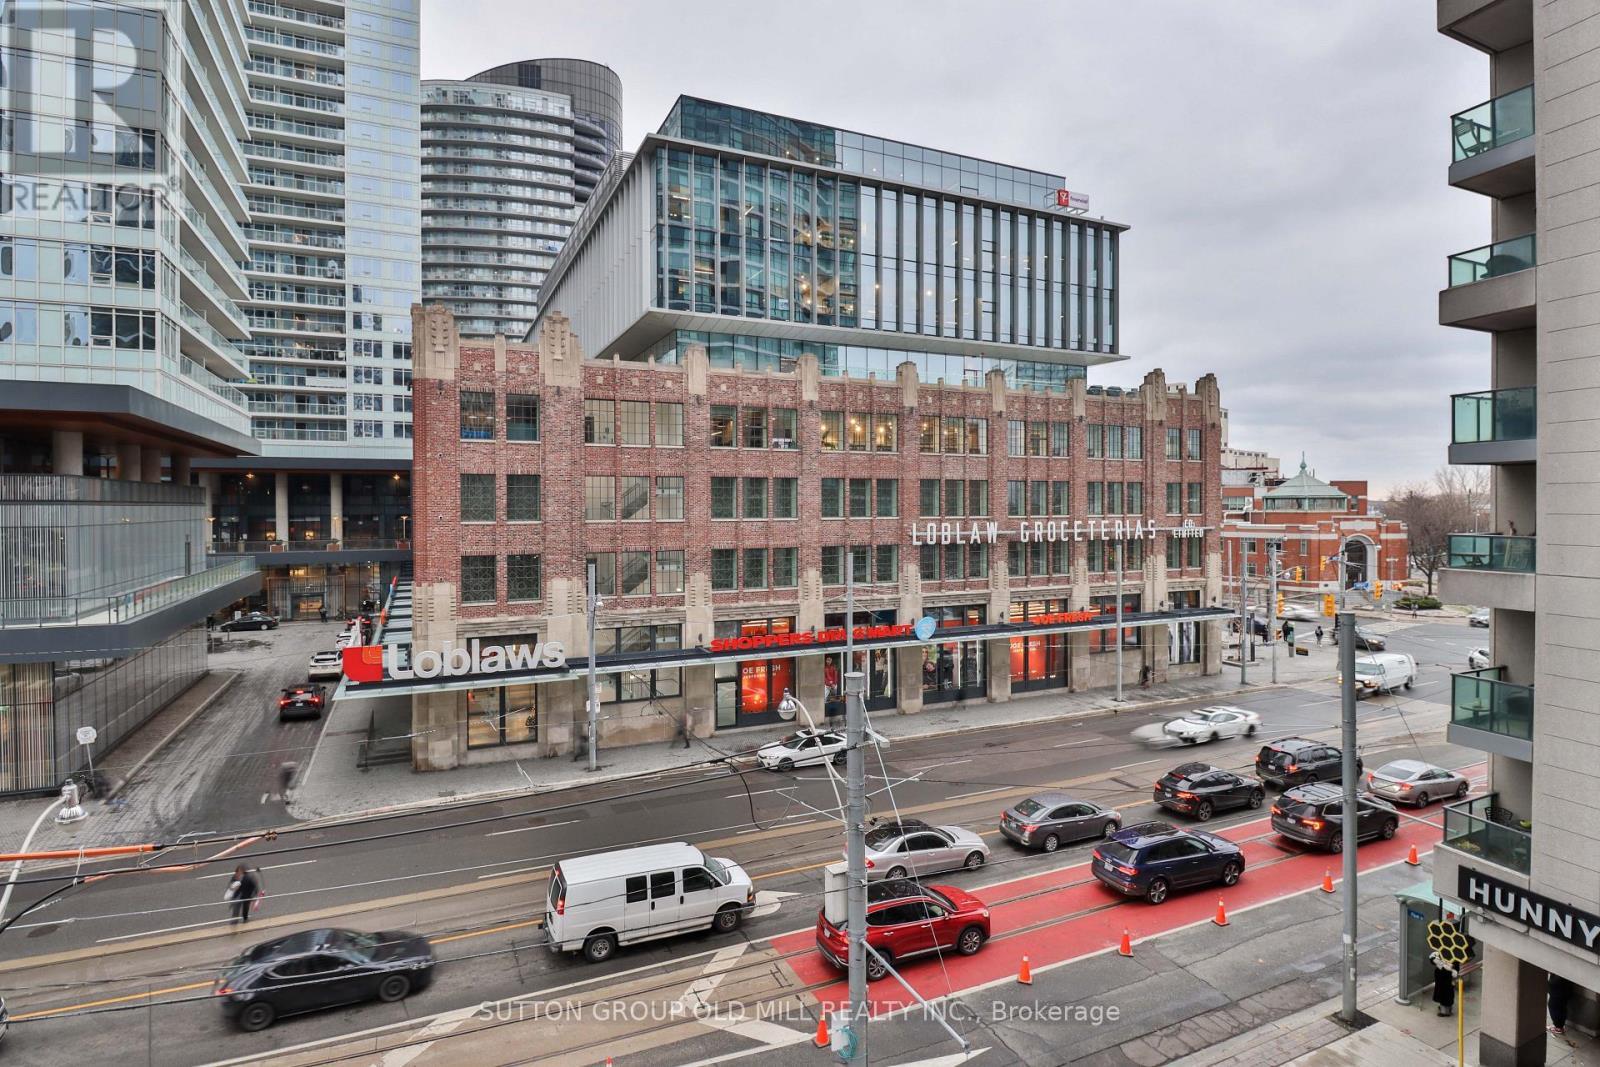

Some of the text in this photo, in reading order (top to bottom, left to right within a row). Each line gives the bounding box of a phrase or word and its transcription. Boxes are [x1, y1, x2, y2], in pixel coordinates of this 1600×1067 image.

[912, 519, 1156, 546] LOBLAW GROCETERIAS
[710, 631, 813, 652] SHOPPERS
[867, 624, 913, 638] MART
[387, 638, 566, 680] Loblaws
[756, 664, 781, 673] FRSH
[1469, 878, 1600, 948] HUNNY
